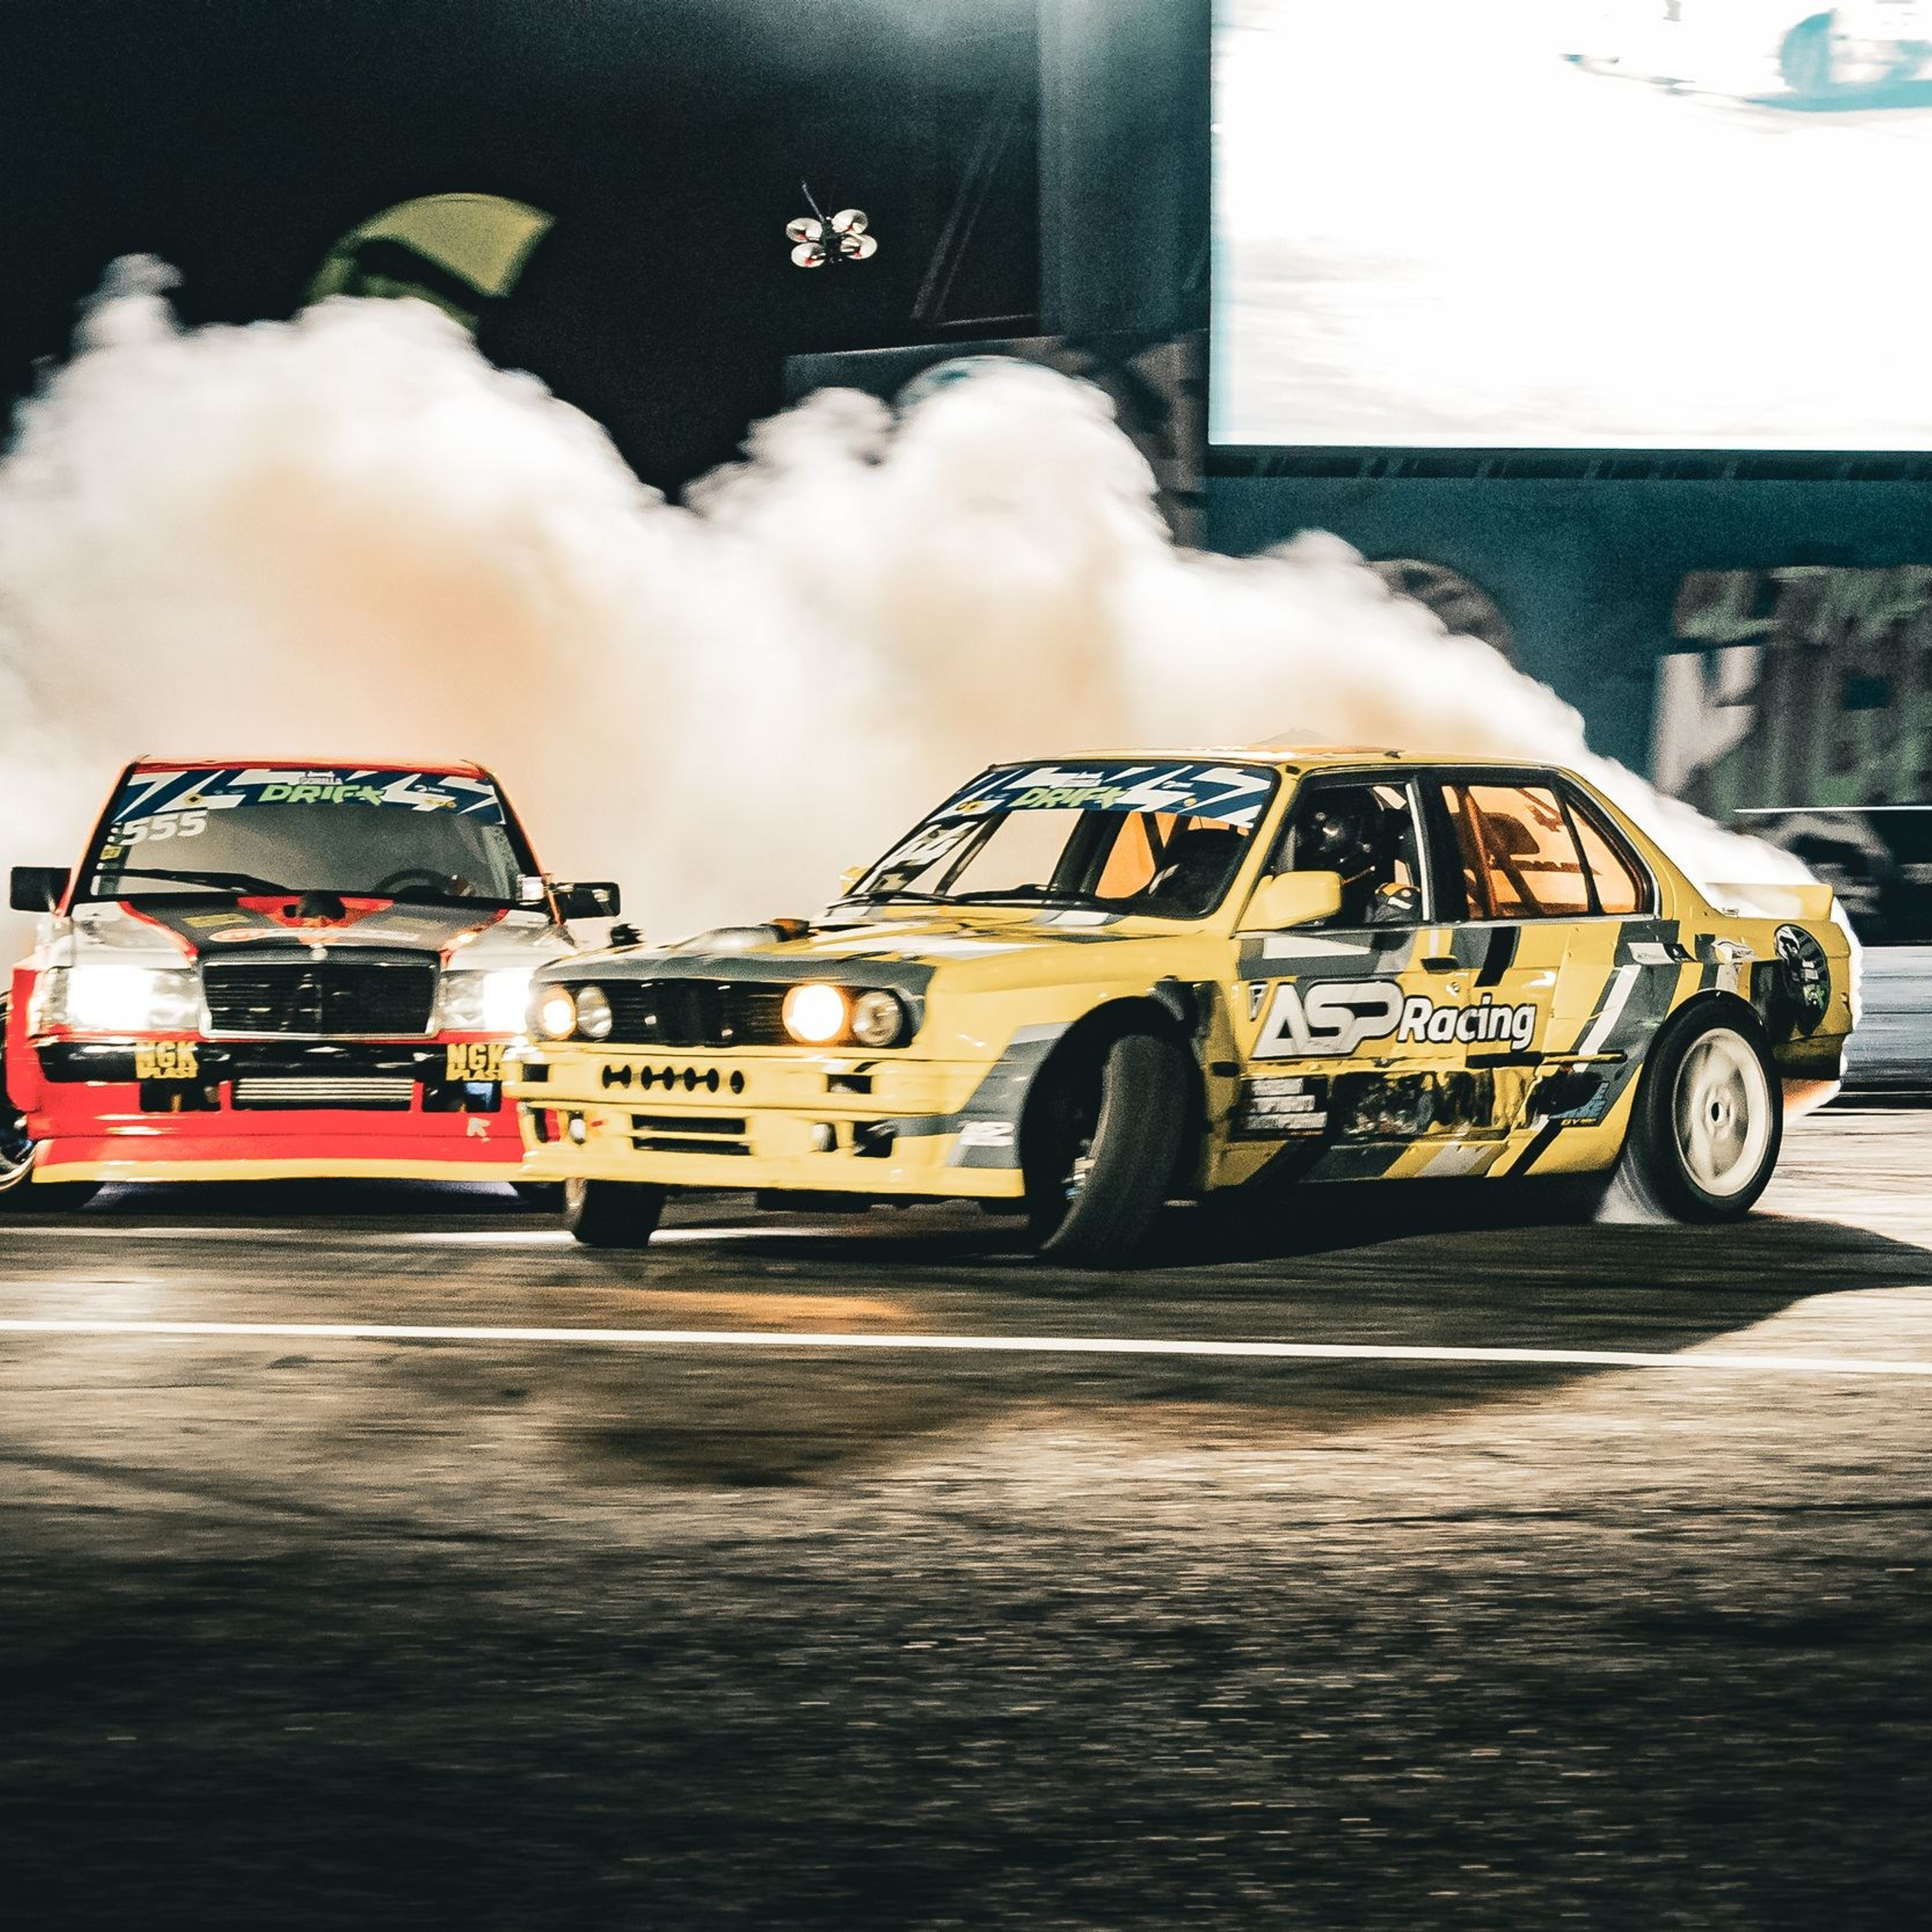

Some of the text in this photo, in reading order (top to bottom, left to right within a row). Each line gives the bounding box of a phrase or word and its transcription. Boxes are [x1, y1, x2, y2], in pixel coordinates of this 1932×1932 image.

[258, 785, 383, 805] DRIFT
[1008, 786, 1128, 809] DRIFT
[118, 810, 208, 845] 555
[1251, 982, 1537, 1057] ASP Racing
[136, 1041, 198, 1067] NGK
[447, 1044, 506, 1069] NGK
